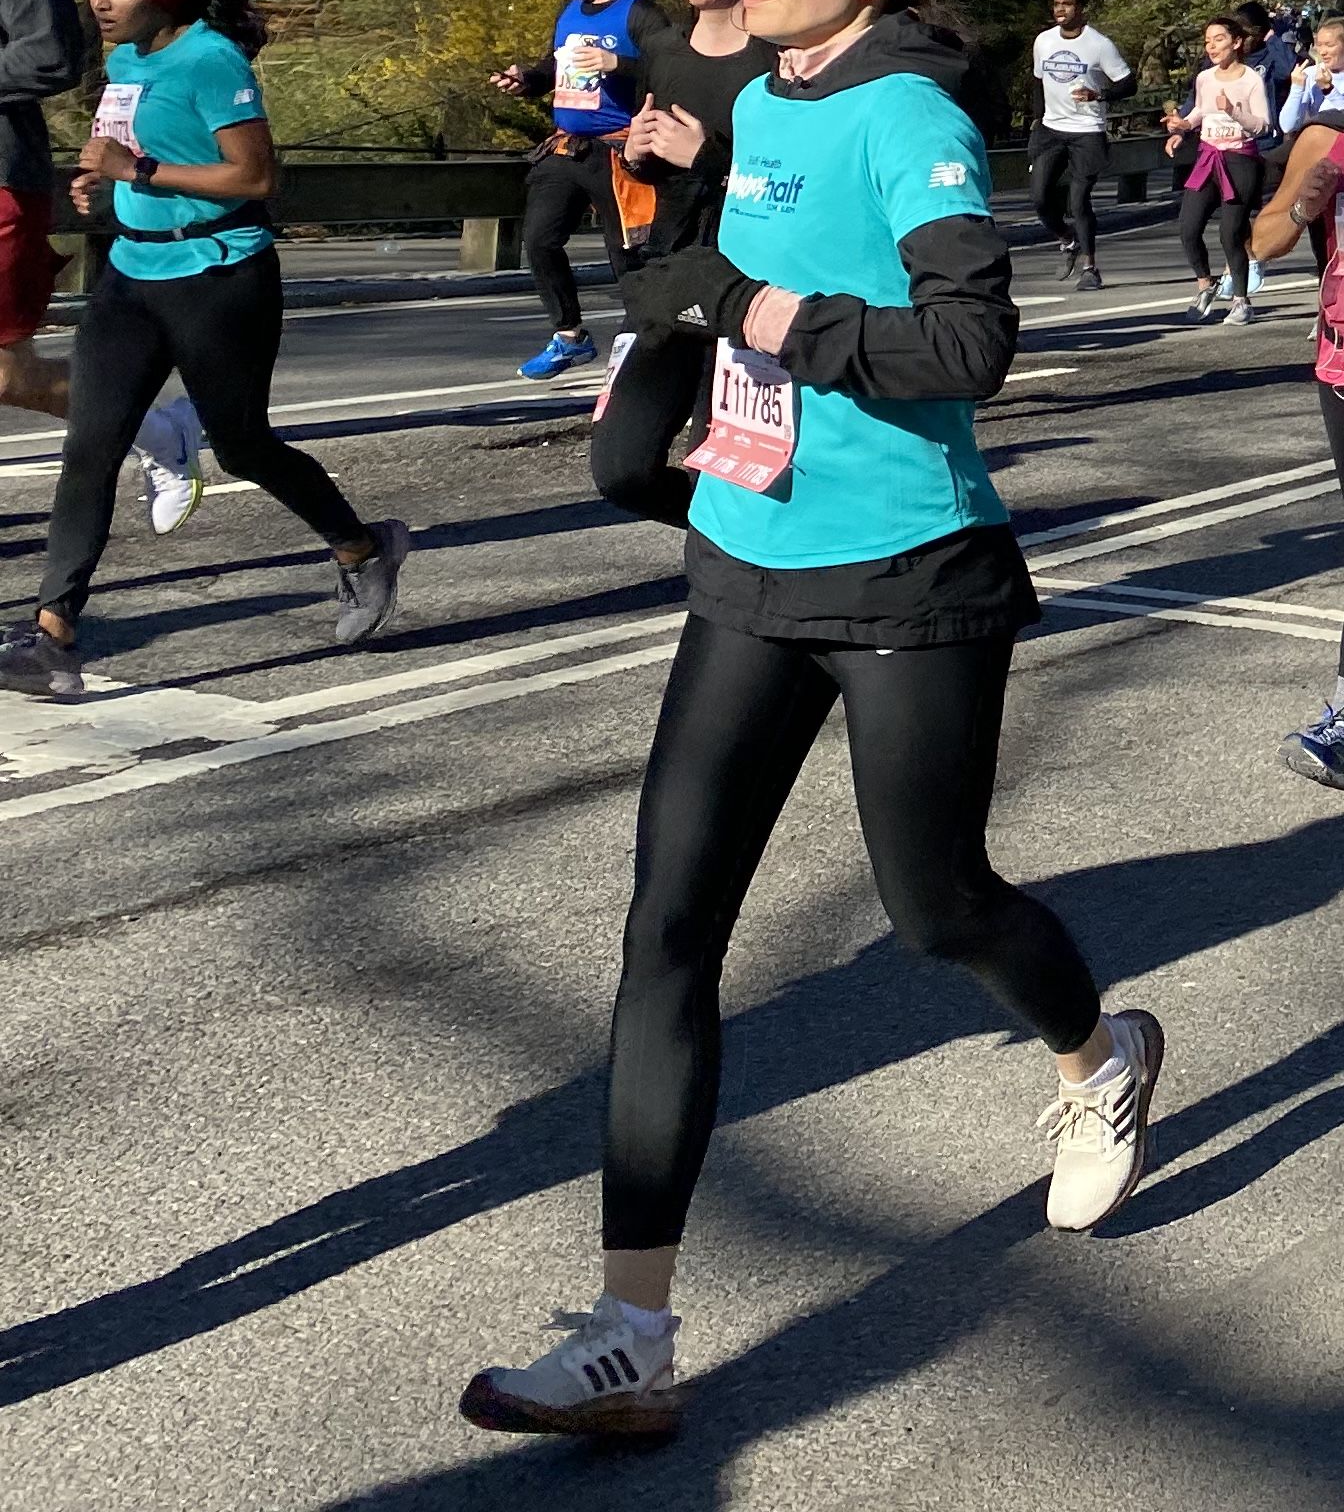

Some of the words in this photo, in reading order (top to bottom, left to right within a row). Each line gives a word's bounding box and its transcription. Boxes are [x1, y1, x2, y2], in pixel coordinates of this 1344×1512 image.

[1043, 61, 1085, 74] PHILADELPHIA
[762, 173, 806, 204] half
[734, 374, 783, 427] 11785
